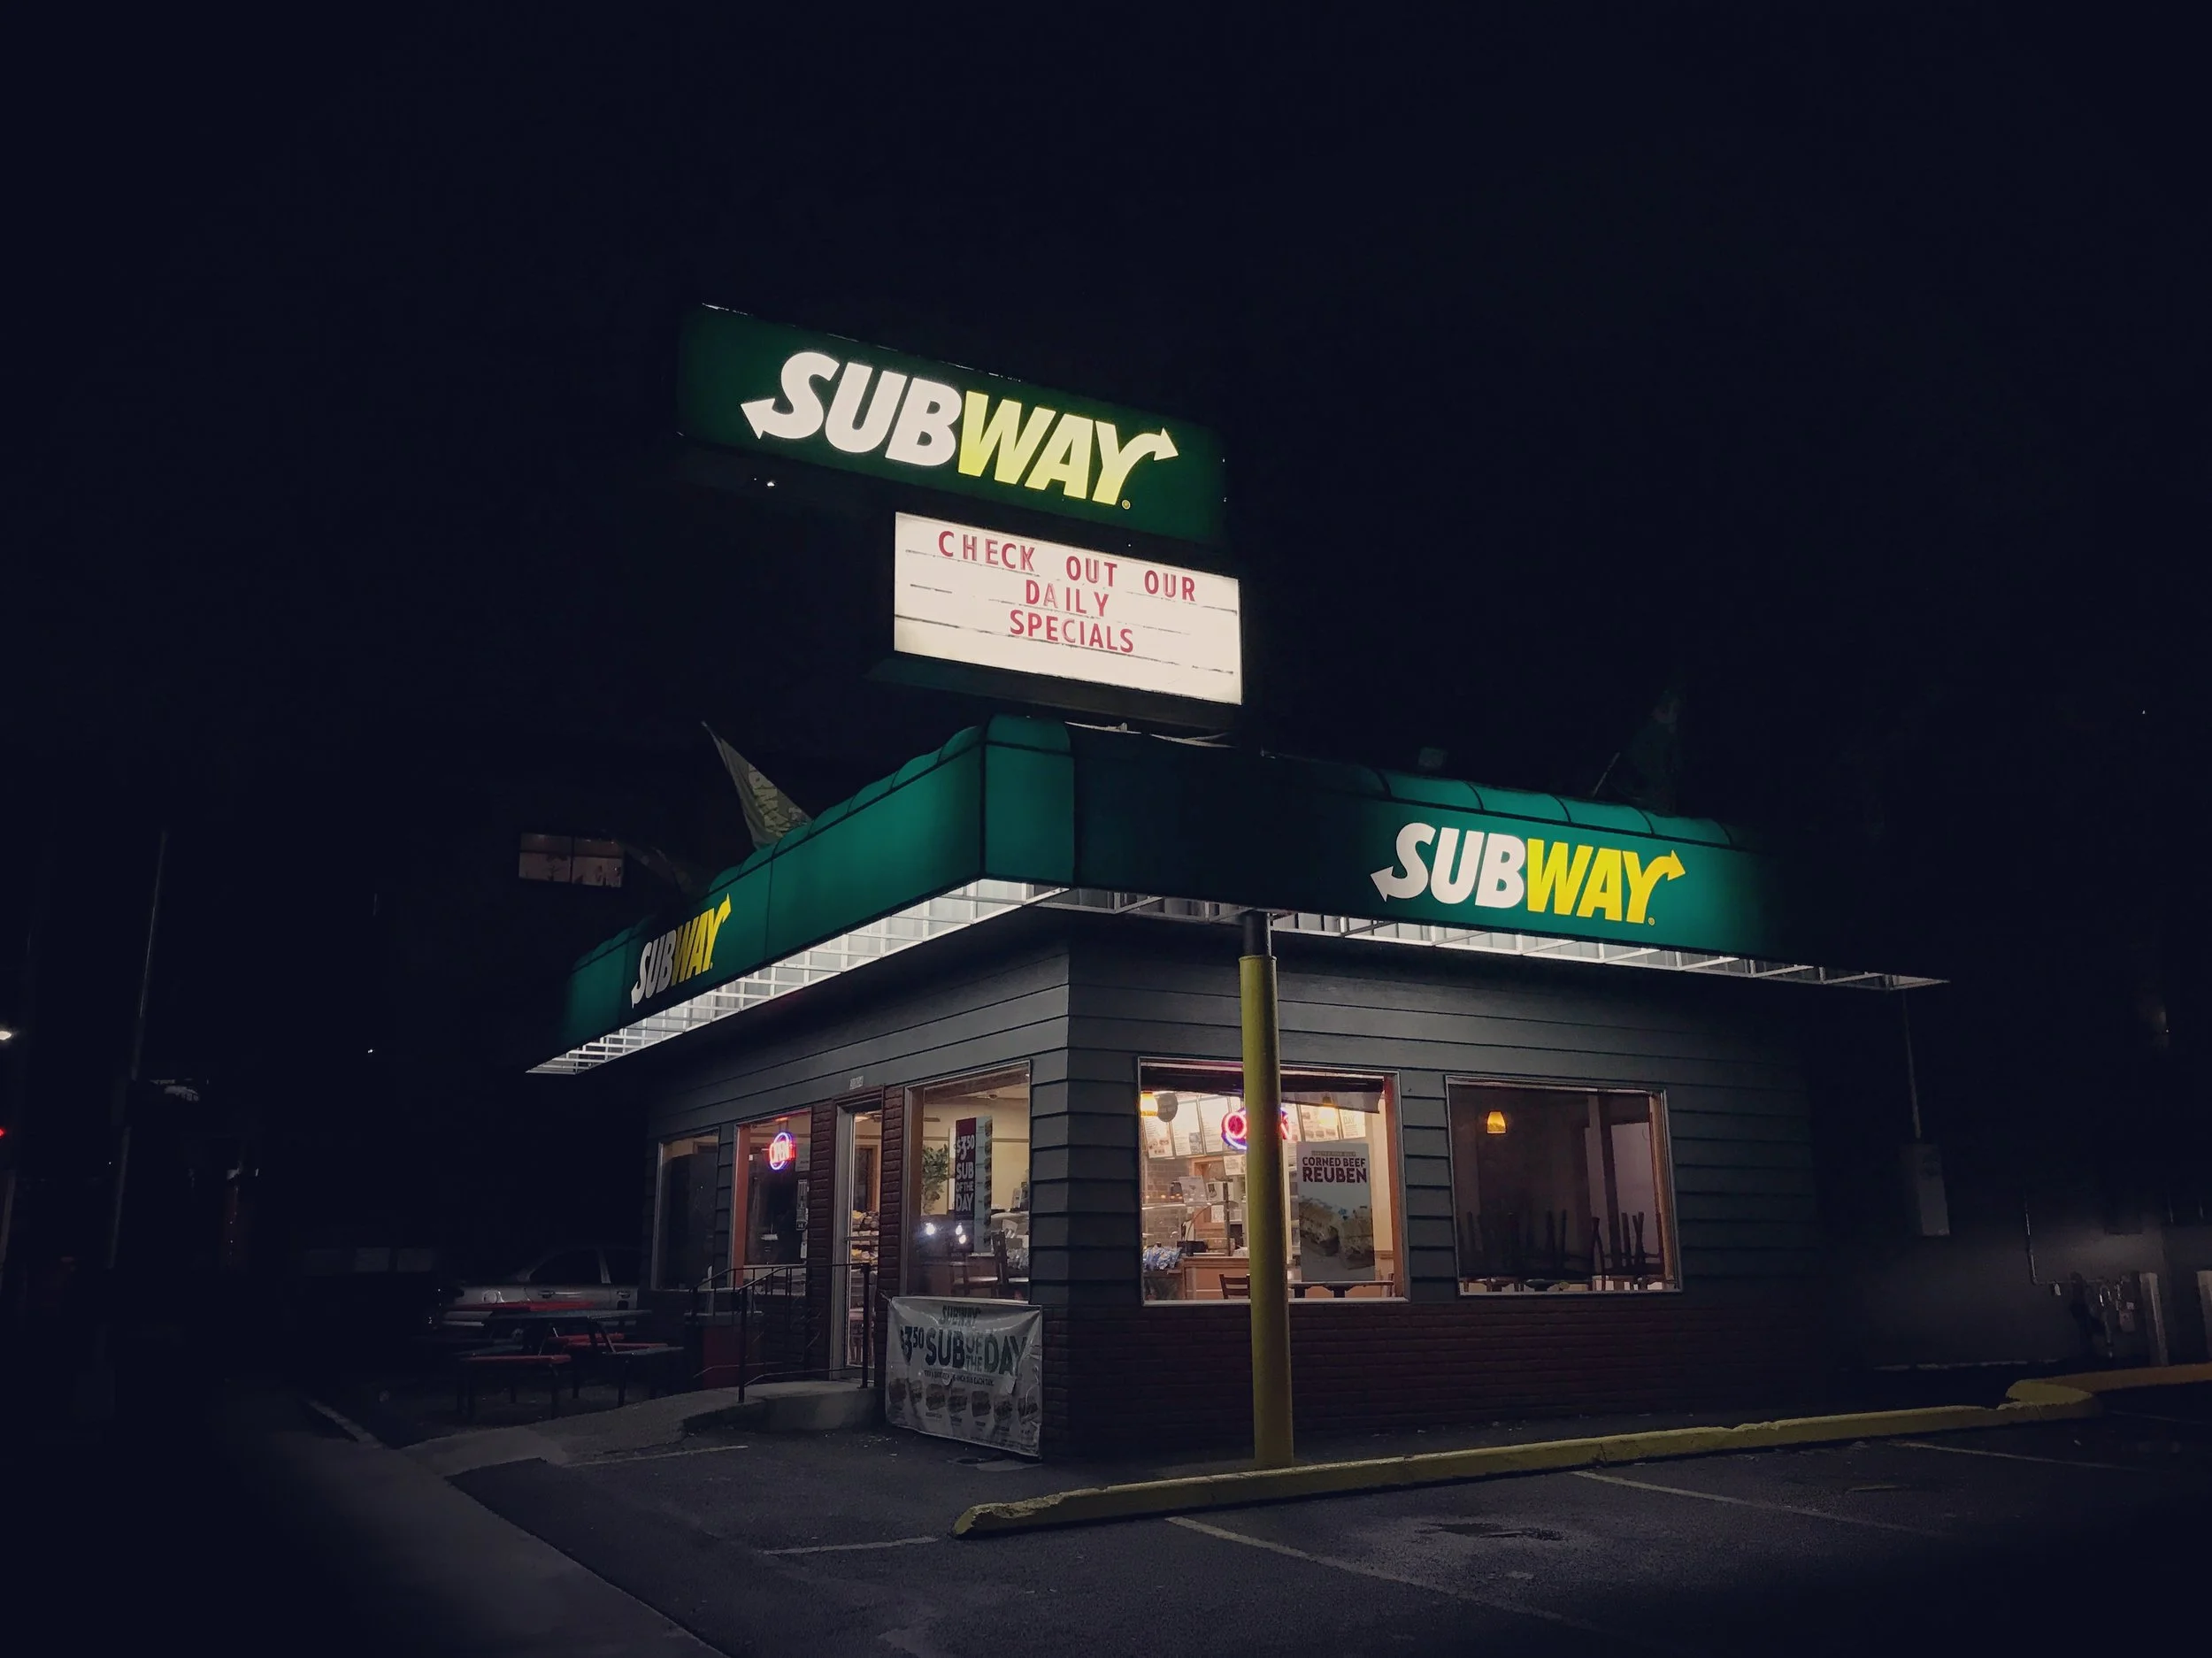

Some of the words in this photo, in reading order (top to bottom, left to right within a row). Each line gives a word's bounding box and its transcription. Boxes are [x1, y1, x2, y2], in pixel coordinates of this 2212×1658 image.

[741, 351, 1179, 505] SUBWAY
[938, 530, 1035, 572] CHECK
[1065, 556, 1118, 587] OUT
[1144, 570, 1195, 602] OUR
[1025, 580, 1110, 617] DAILY
[1010, 610, 1133, 653] SPECIALS
[1371, 823, 1686, 924] SUBWAY
[631, 893, 731, 1009] SUBWAY
[956, 1161, 974, 1179] SUB
[1302, 1156, 1341, 1167] CORNED
[1343, 1157, 1366, 1167] BEEF
[1302, 1167, 1367, 1183] REUBEN
[956, 1181, 963, 1193] OF
[963, 1180, 974, 1192] THE
[956, 1193, 974, 1212] DAY
[926, 1328, 964, 1369] SUB
[965, 1354, 983, 1372] THE
[966, 1335, 983, 1354] OF
[984, 1333, 1027, 1377] DAY
